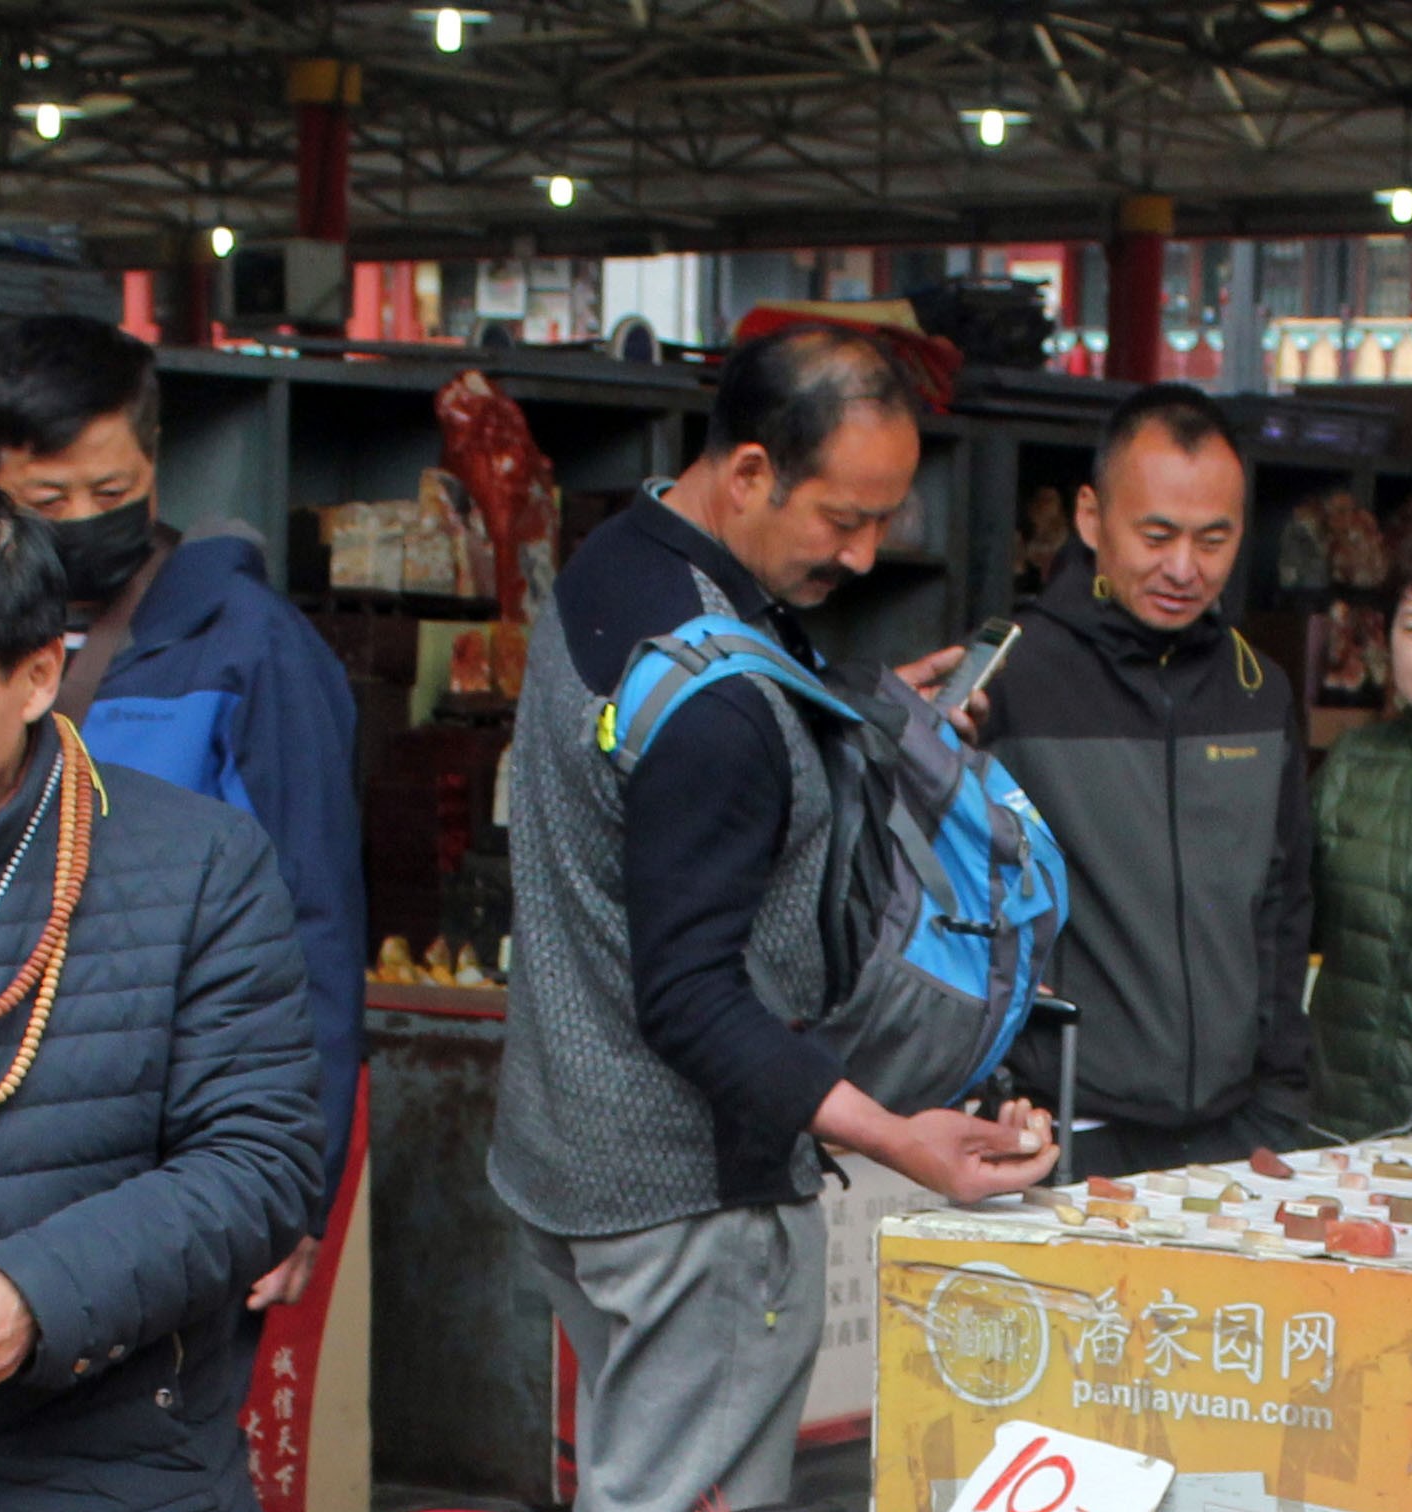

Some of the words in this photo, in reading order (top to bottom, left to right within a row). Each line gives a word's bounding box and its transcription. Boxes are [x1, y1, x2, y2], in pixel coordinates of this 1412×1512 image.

[1069, 1286, 1336, 1393] 潘家园网
[1072, 1378, 1334, 1430] panjiayuan.com
